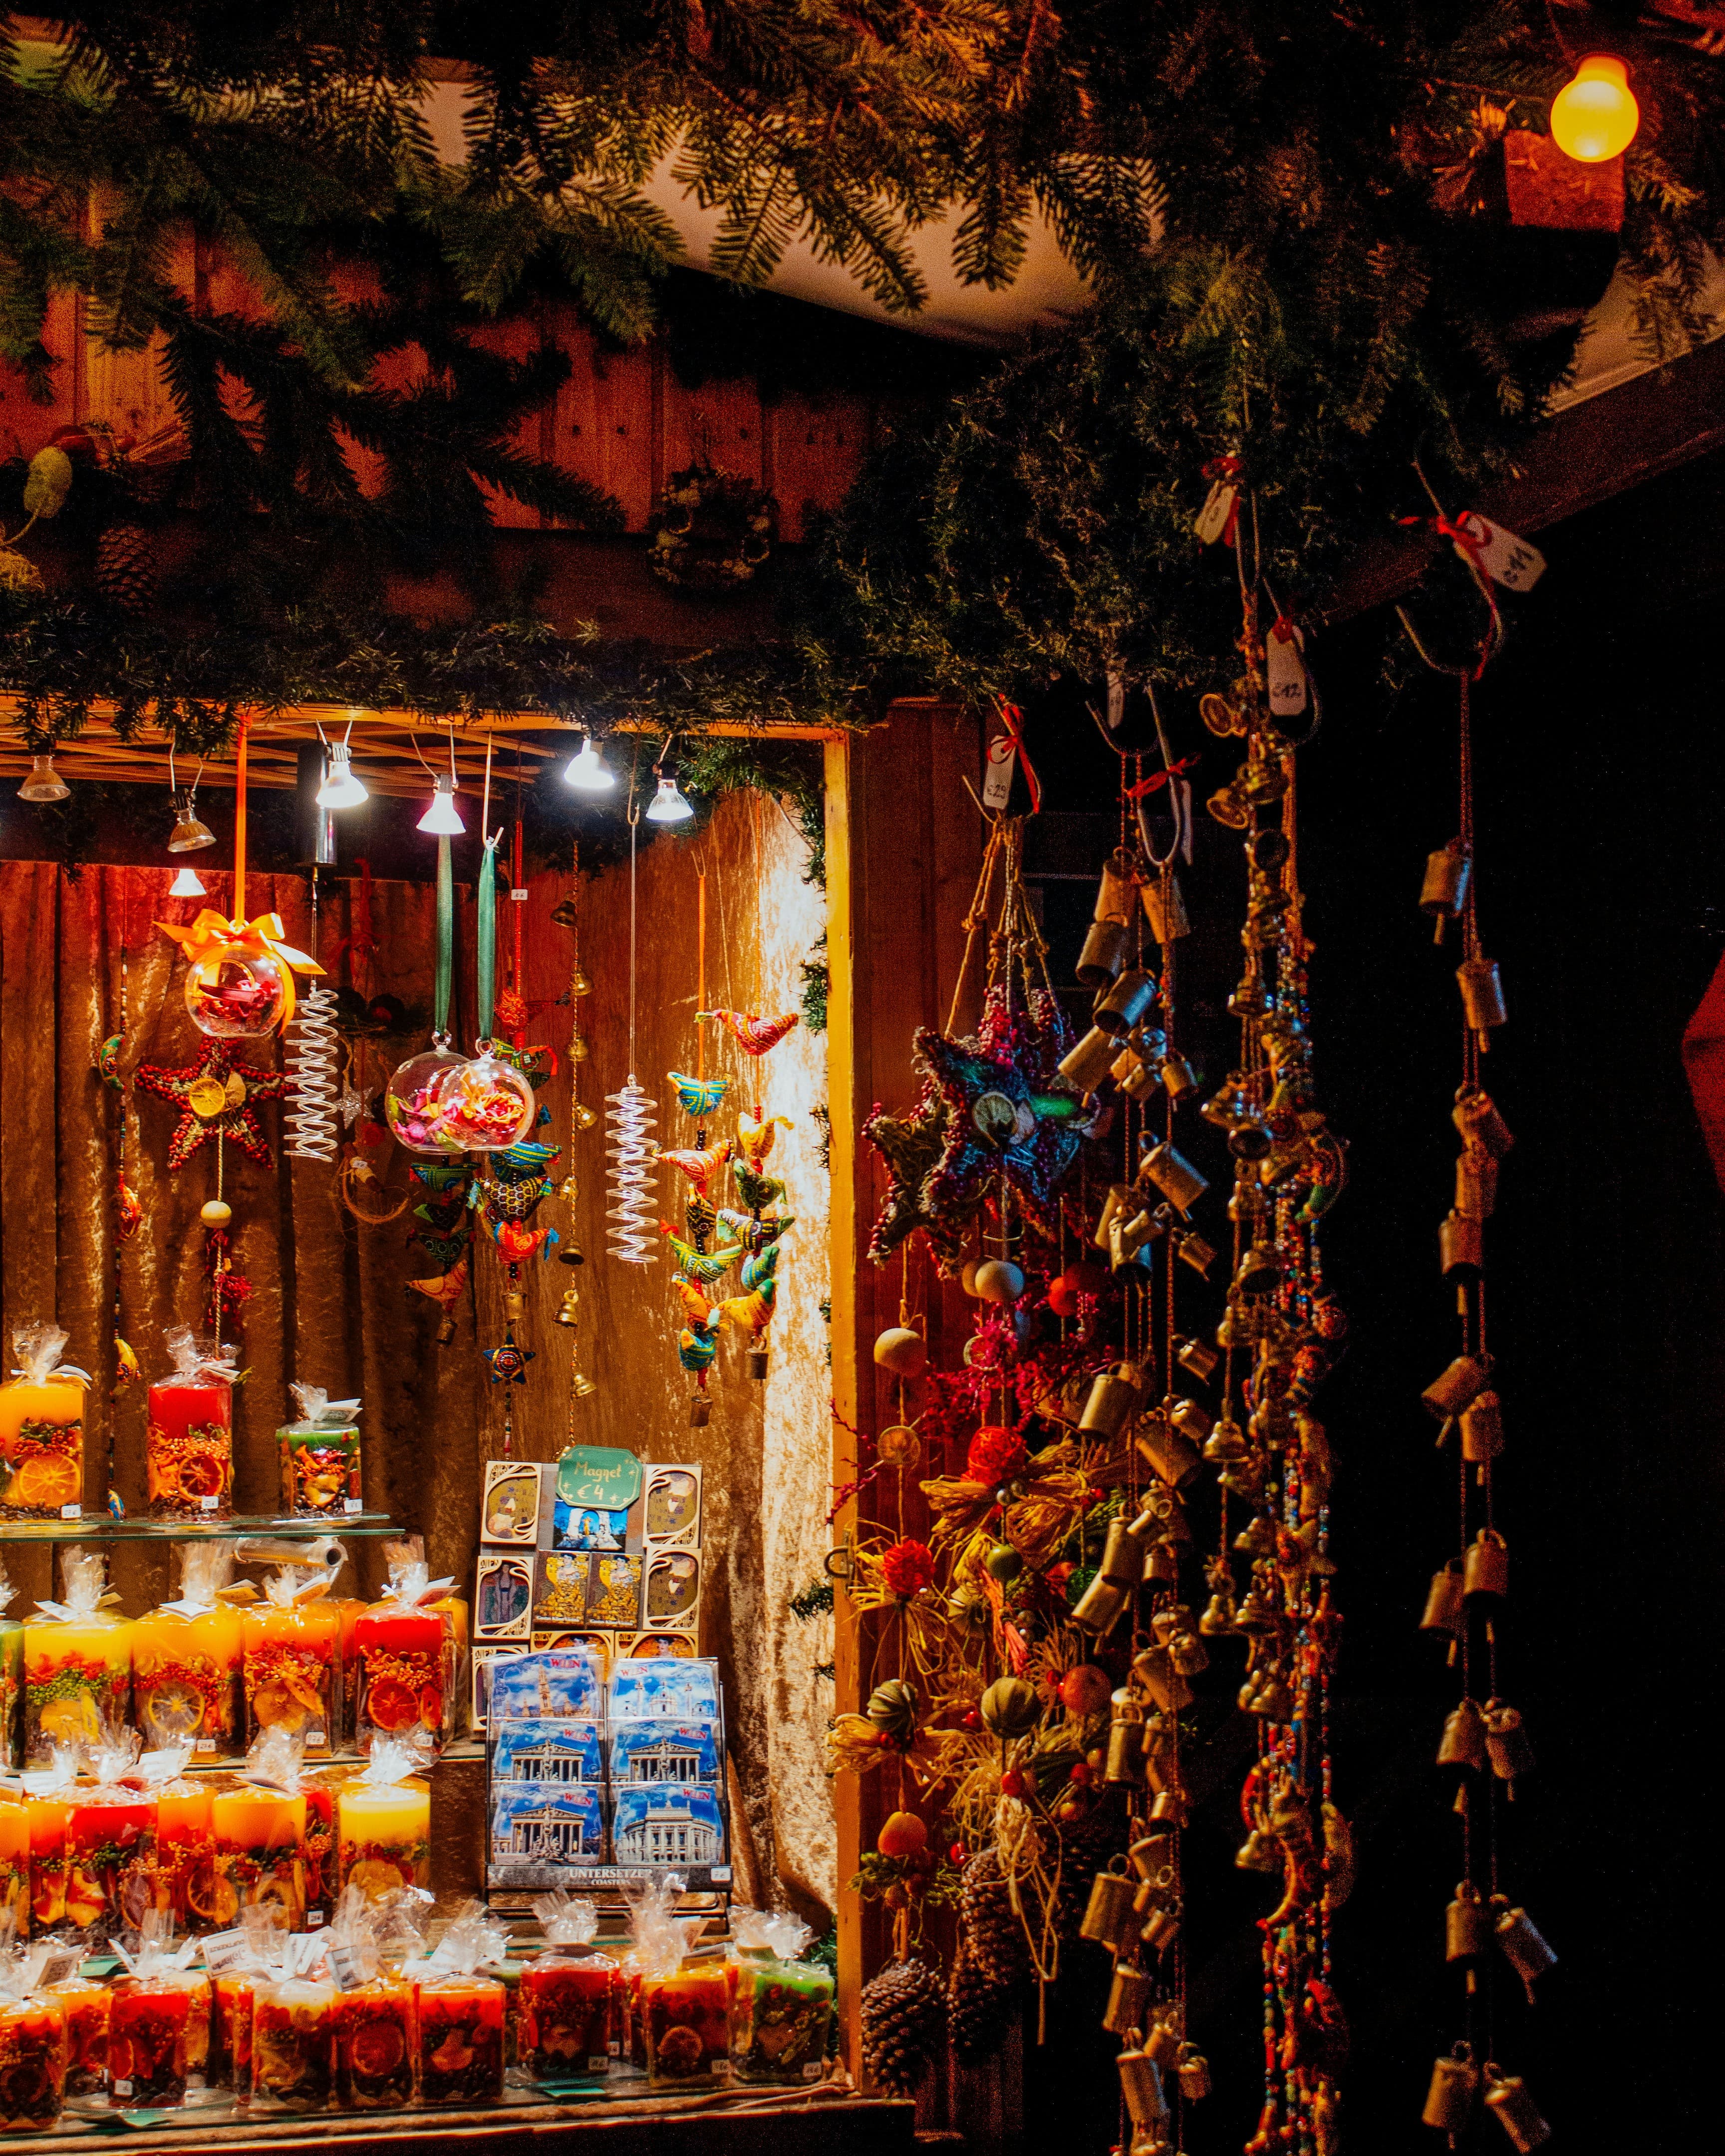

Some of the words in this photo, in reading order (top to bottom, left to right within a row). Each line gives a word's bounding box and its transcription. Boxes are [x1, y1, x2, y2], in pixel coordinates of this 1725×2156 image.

[574, 1461, 621, 1482] Magnet
[577, 1484, 592, 1499] €
[594, 1485, 604, 1500] 4
[551, 1658, 581, 1668] WIEN
[564, 1729, 592, 1741] WIEN
[679, 1727, 707, 1740] WIEN
[564, 1792, 592, 1805] WIEN
[682, 1788, 710, 1800] WIEN
